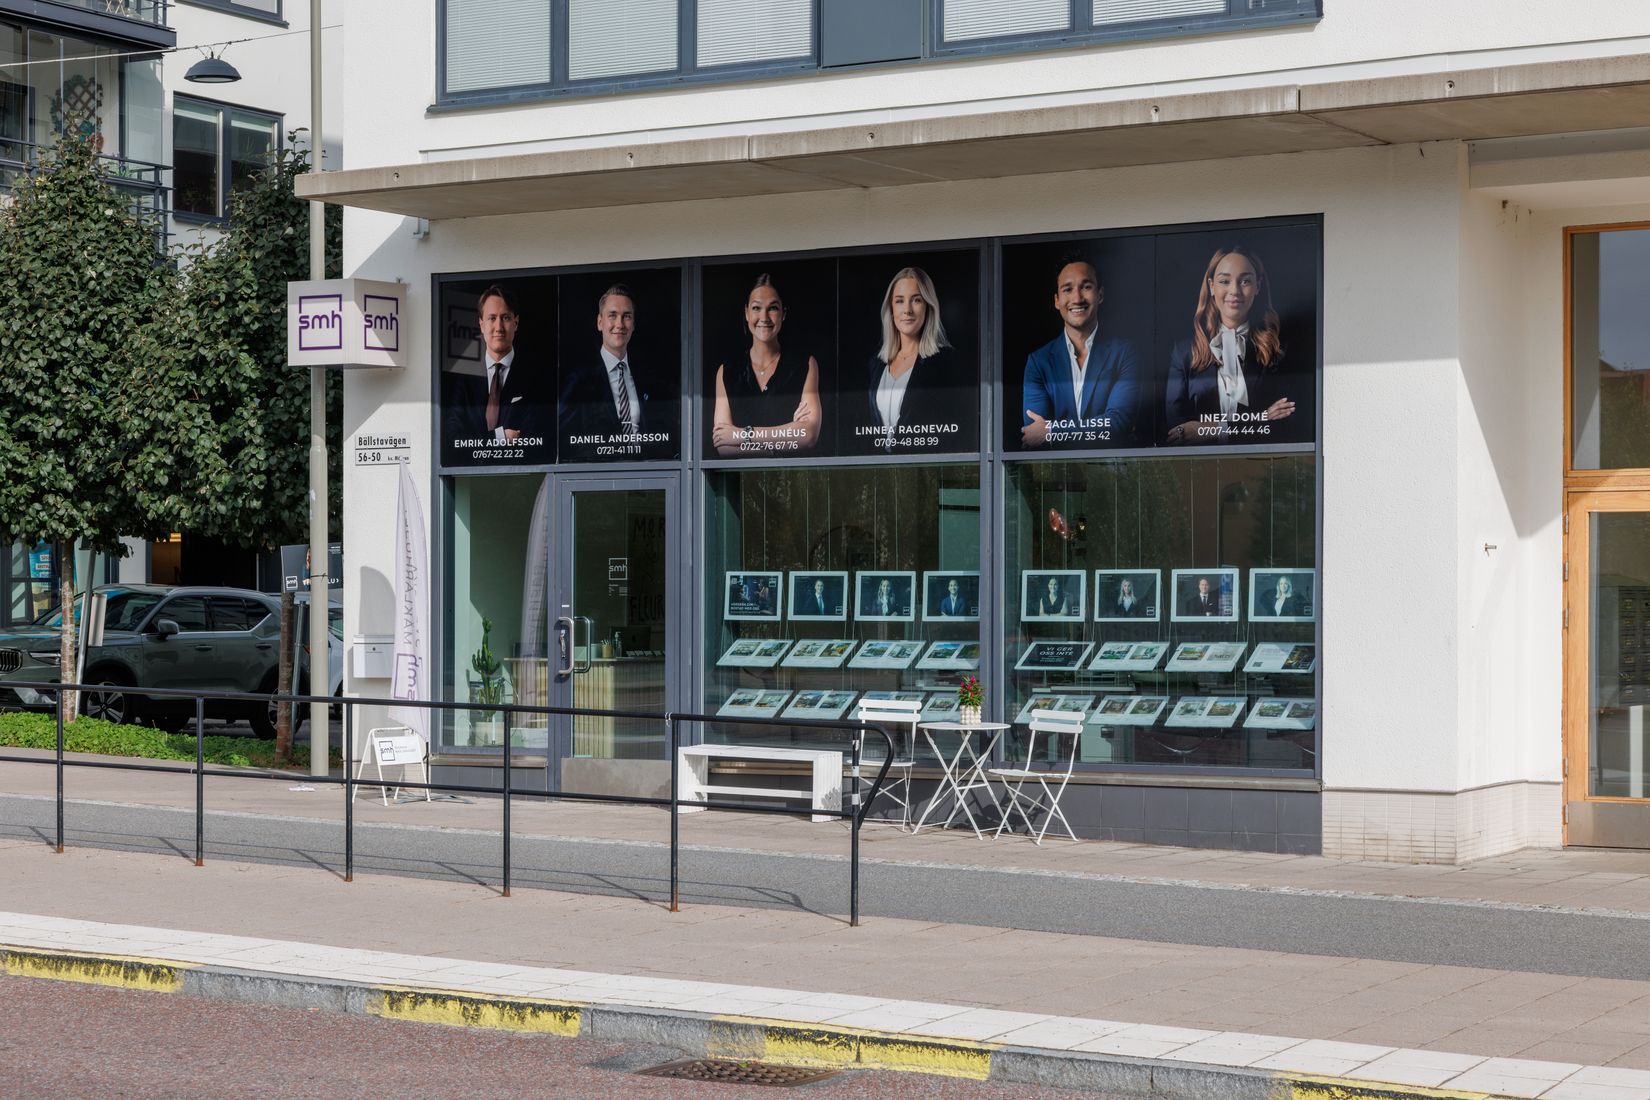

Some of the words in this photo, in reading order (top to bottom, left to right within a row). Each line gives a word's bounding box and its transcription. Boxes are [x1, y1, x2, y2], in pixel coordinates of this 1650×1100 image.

[299, 310, 342, 329] smh
[364, 313, 399, 331] smh
[1200, 413, 1228, 423] INEZ
[1232, 410, 1269, 422] DOMÉ
[898, 424, 959, 434] RAGNEVAD
[1044, 419, 1076, 429] ZAGA
[1079, 418, 1111, 428] LISSE
[732, 430, 768, 439] NOOMI
[771, 428, 807, 438] UNÉUS
[1045, 431, 1083, 442] 0707-77
[1084, 431, 1096, 441] 35
[1097, 430, 1111, 440] 42
[1197, 426, 1239, 436] 0707-44
[1241, 425, 1255, 435] 44
[1256, 425, 1271, 435] 46
[358, 436, 407, 448] Bällstavägen
[454, 439, 484, 448] EMRIK
[486, 437, 543, 447] ADOLFSSON
[569, 435, 606, 444] DANIEL
[608, 433, 669, 443] ANDERSSON
[874, 437, 912, 447] 0709-48
[913, 437, 926, 446] 88
[927, 436, 939, 446] 99
[596, 445, 626, 455] 0721-41
[627, 445, 634, 454] 11
[635, 445, 641, 454] 11
[740, 441, 774, 451] 0722-76
[775, 441, 786, 450] 67
[787, 441, 798, 450] 76
[358, 452, 381, 462] 56-50
[472, 450, 503, 459] 0767-22
[503, 449, 513, 458] 22
[514, 449, 524, 458] 22
